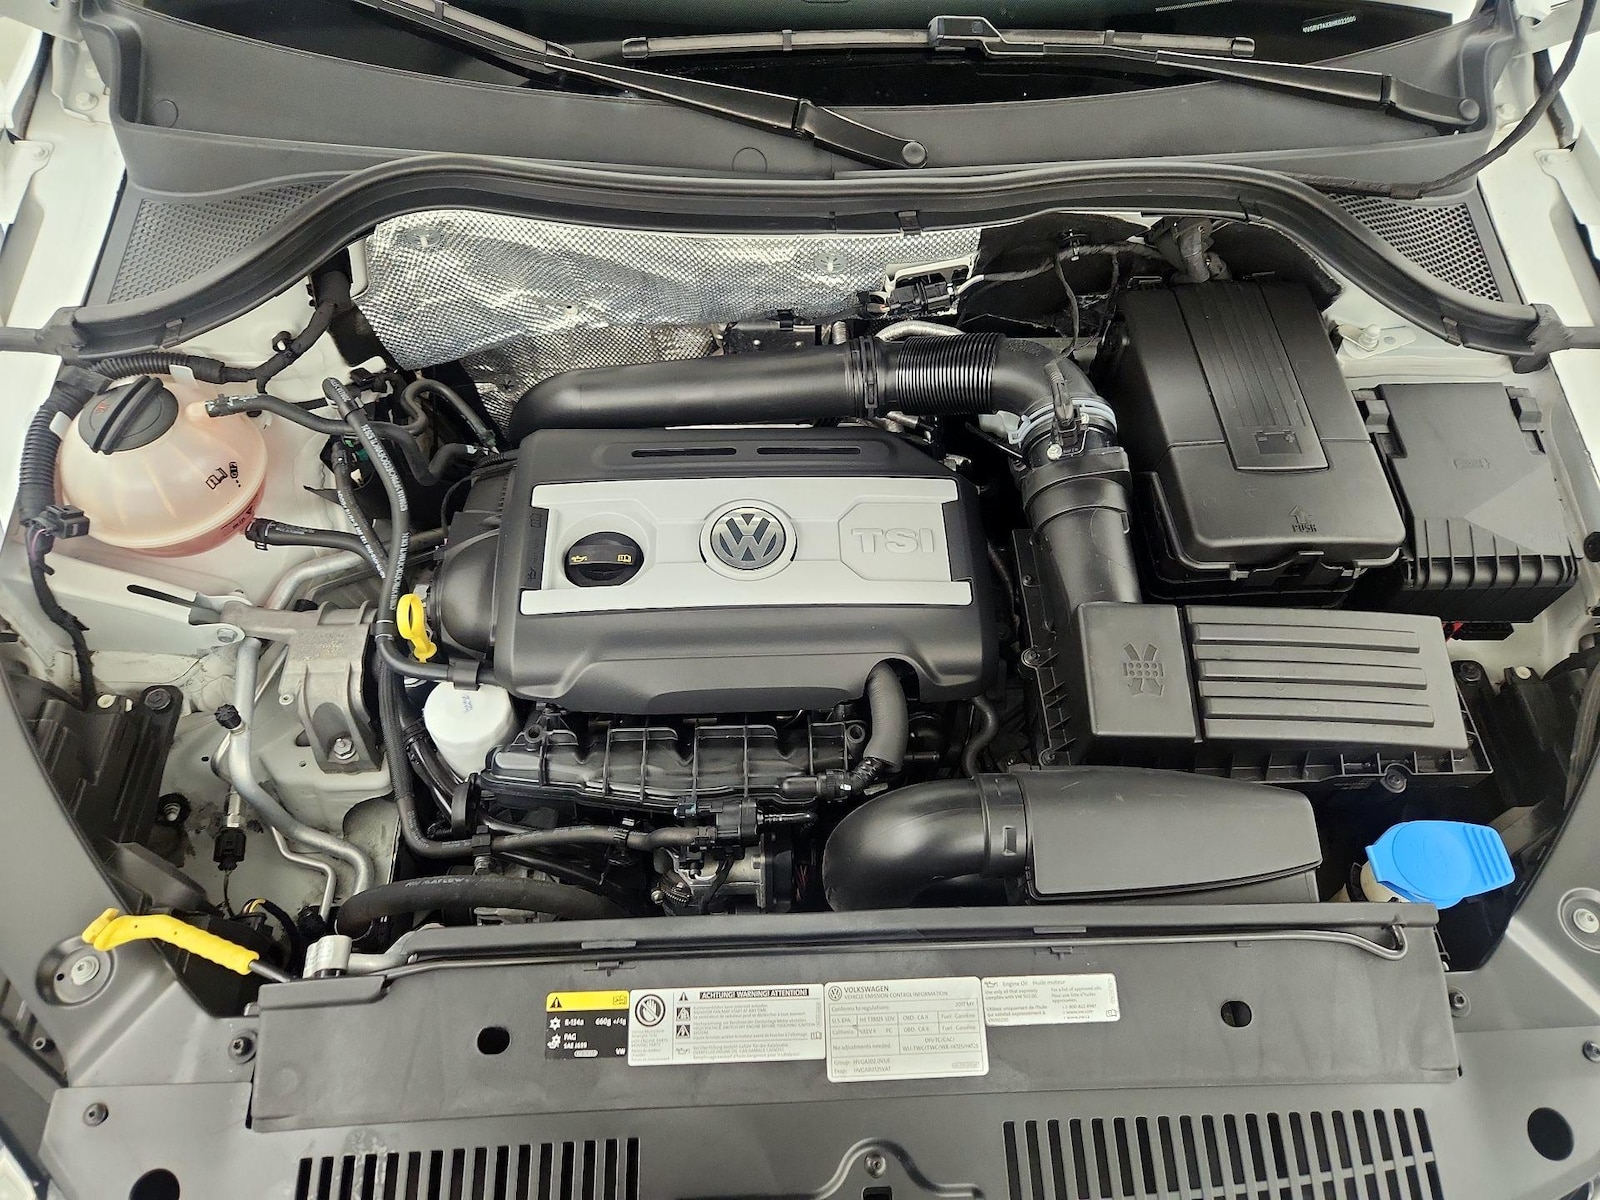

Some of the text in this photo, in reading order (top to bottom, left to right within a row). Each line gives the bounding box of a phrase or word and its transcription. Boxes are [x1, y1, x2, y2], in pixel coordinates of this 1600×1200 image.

[1291, 523, 1318, 533] PUSH
[711, 508, 786, 570] VW
[851, 527, 935, 554] TSI
[737, 990, 770, 998] WARNING!
[770, 988, 808, 997] ATTENTION!
[844, 985, 889, 993] VOLKSWAGEN
[563, 1032, 577, 1041] PAG
